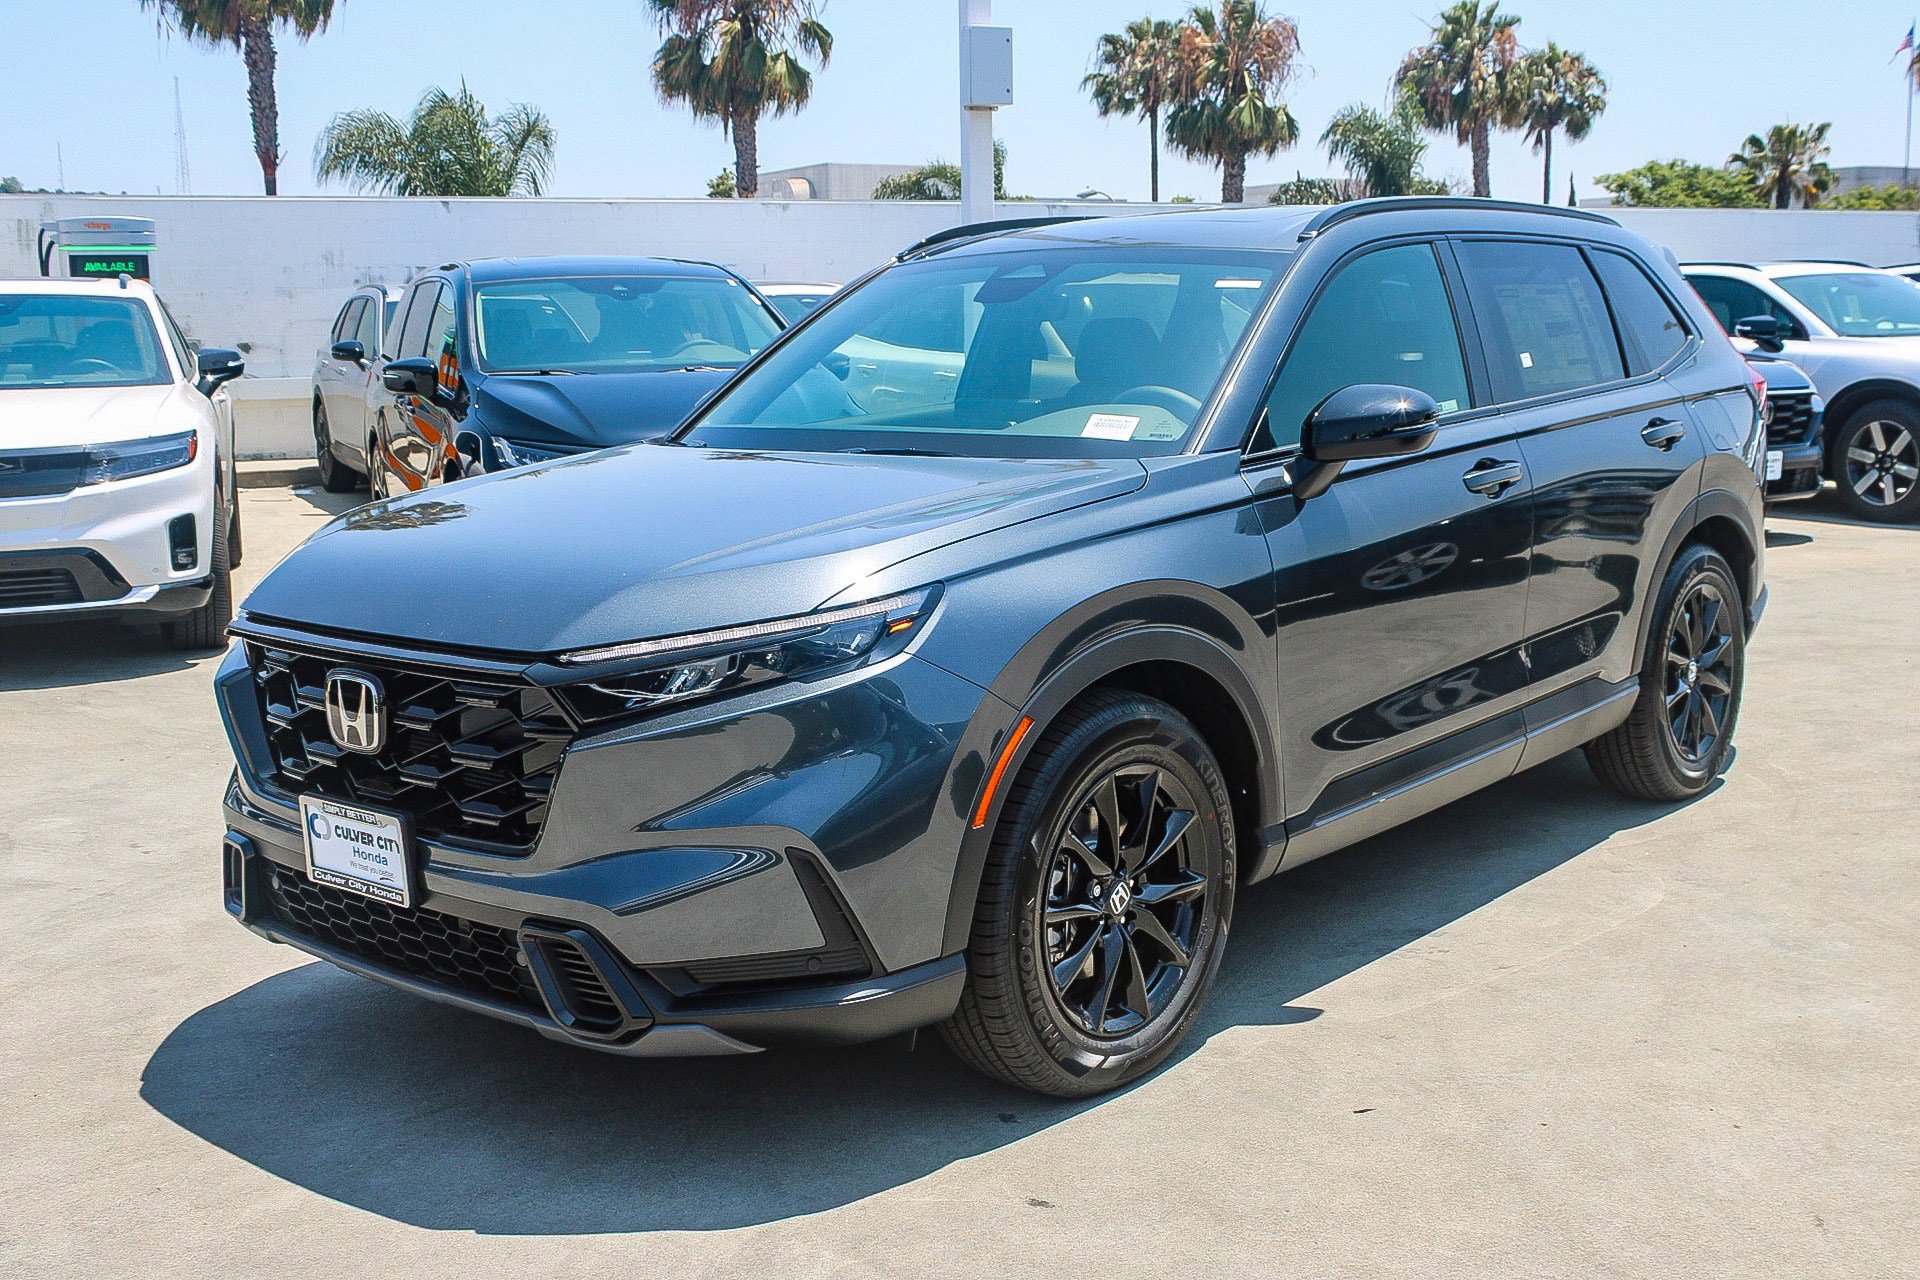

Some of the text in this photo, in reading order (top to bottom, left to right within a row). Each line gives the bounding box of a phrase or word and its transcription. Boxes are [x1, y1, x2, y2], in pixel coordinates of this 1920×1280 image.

[84, 261, 135, 272] AVAILABLE
[323, 804, 376, 824] SIMPLY BETTER
[334, 824, 375, 848] CULVER
[352, 846, 388, 866] Honda
[314, 870, 402, 902] Culver City Honda
